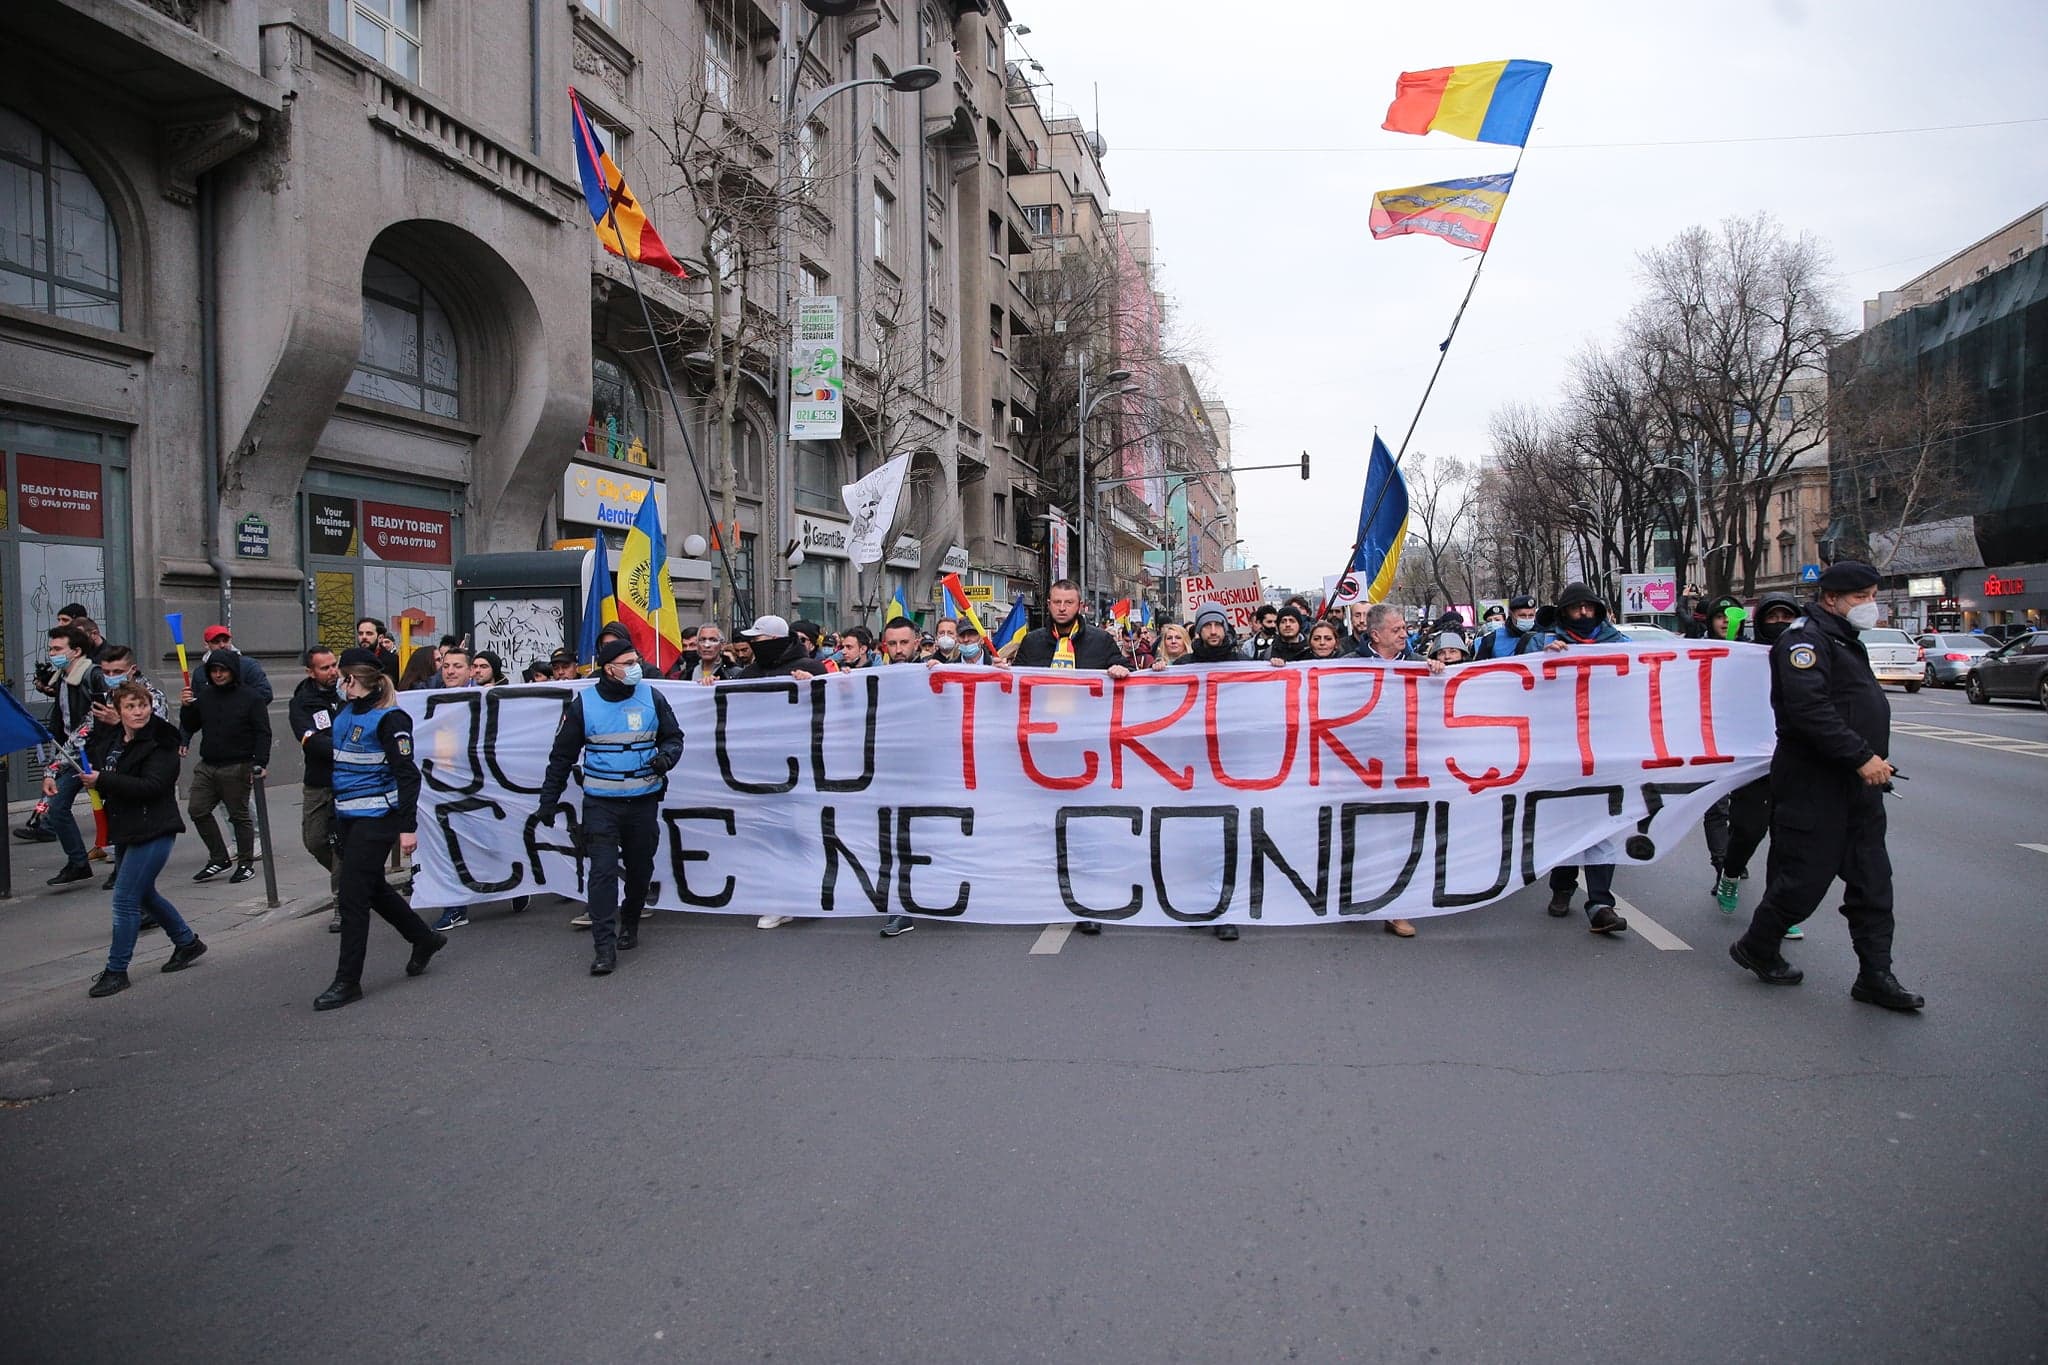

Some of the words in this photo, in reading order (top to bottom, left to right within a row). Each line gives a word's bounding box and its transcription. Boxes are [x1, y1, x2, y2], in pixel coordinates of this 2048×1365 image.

[813, 410, 837, 420] 9662
[21, 484, 56, 495] READY
[59, 488, 71, 497] TO
[73, 489, 98, 500] RENT
[42, 500, 61, 508] 0749
[77, 503, 91, 511] 180
[323, 507, 342, 517] Your
[316, 516, 351, 528] business
[370, 516, 404, 530] READY
[405, 520, 419, 531] TO
[419, 522, 443, 534] RENT
[324, 526, 343, 537] here
[812, 526, 846, 549] GarantiBa
[390, 535, 408, 546] 0749
[409, 537, 423, 547] 077
[423, 539, 437, 549] 180
[1186, 575, 1215, 593] ERA
[715, 675, 879, 793] CU
[436, 799, 736, 908] CAE
[820, 806, 975, 917] NE
